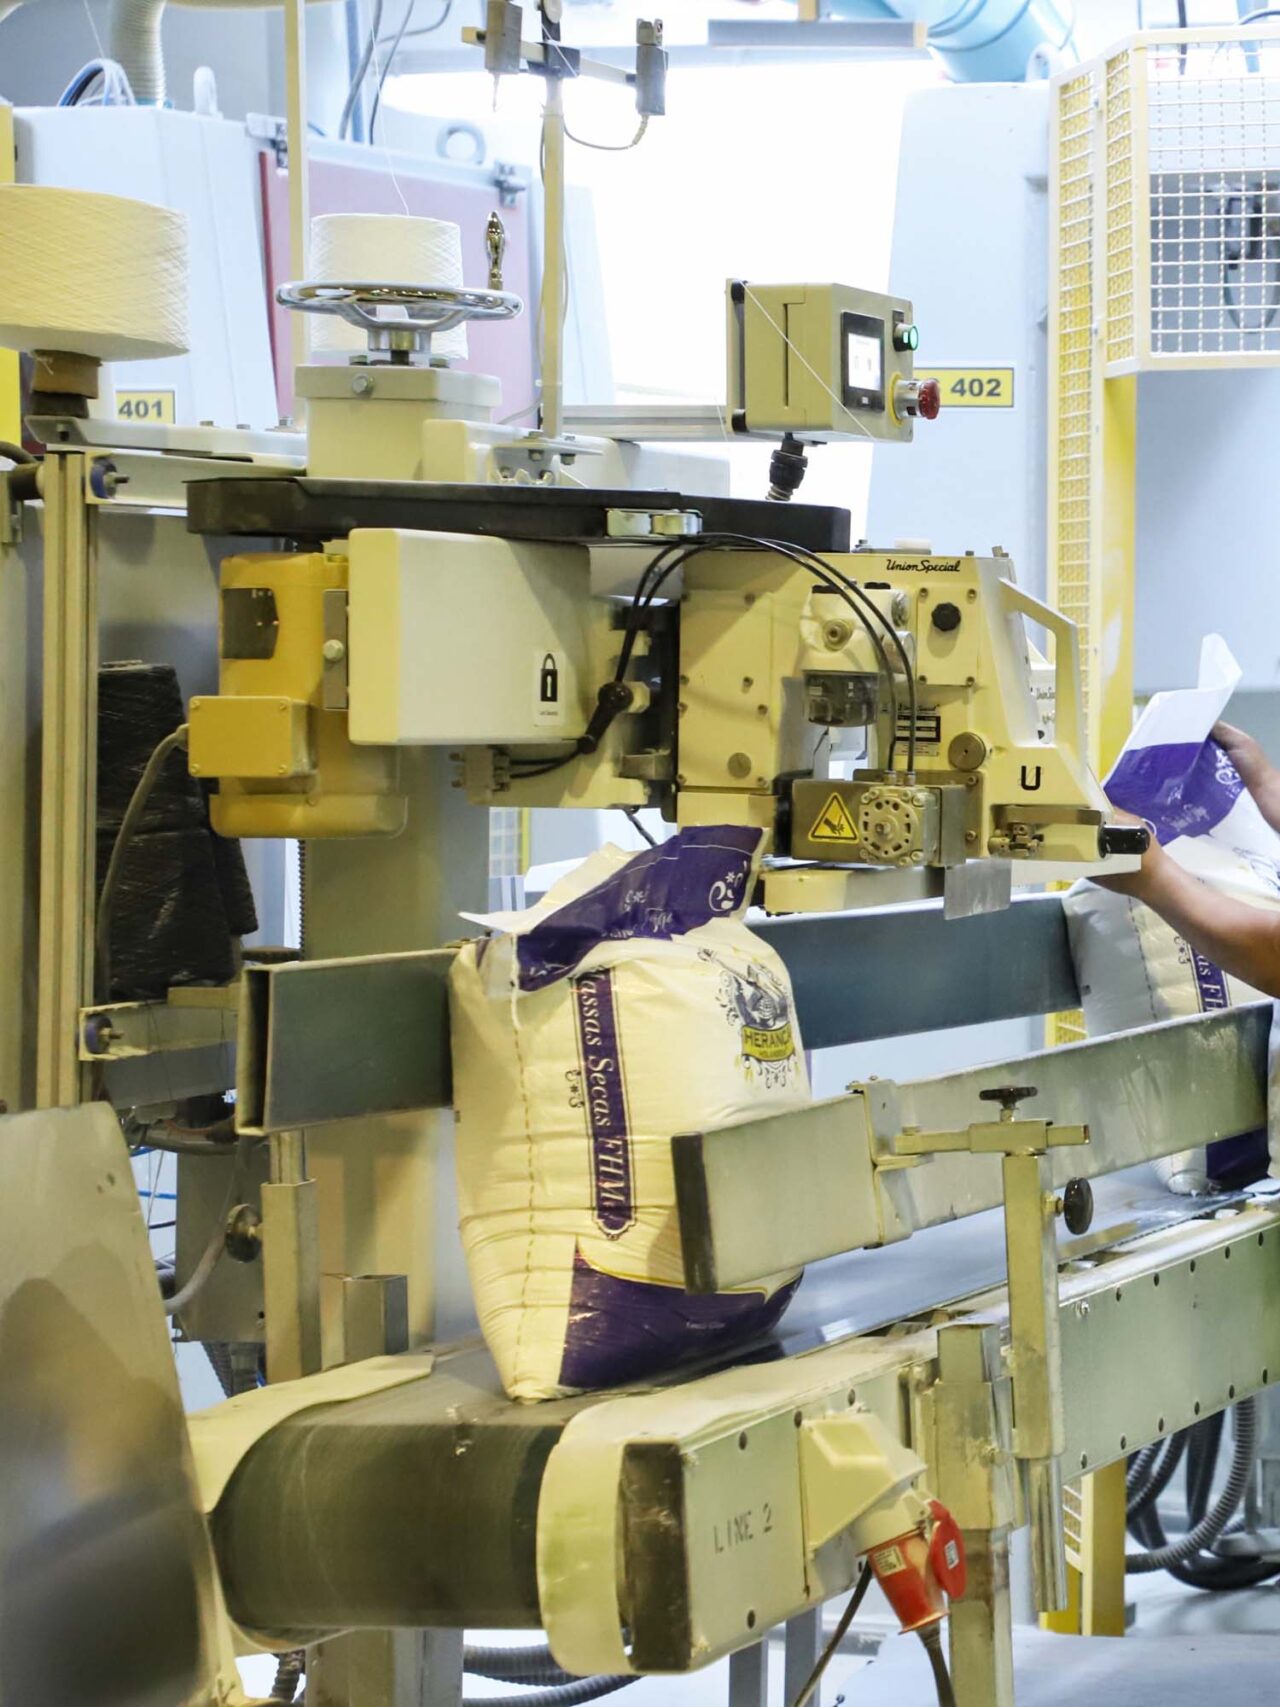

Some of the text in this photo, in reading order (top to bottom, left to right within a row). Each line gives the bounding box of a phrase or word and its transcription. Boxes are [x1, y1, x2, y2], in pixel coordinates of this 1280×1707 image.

[951, 378, 1001, 397] 402
[118, 399, 162, 418] 401
[1020, 765, 1041, 791] U
[588, 1055, 615, 1127] Secas
[713, 1502, 773, 1554] LINE 2
